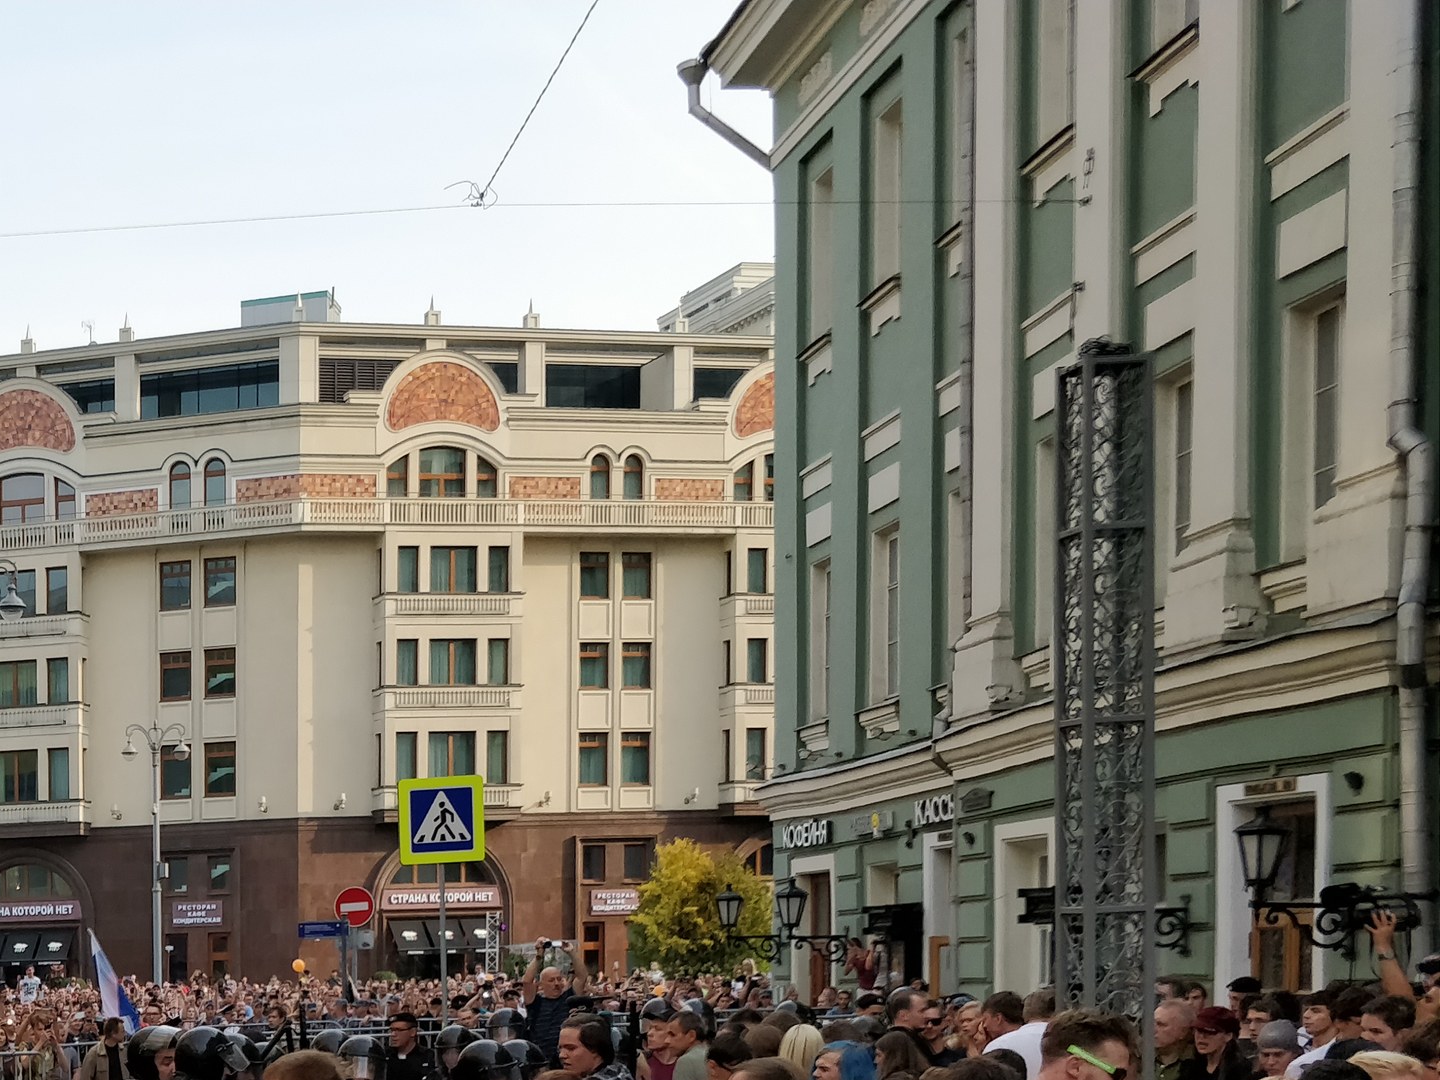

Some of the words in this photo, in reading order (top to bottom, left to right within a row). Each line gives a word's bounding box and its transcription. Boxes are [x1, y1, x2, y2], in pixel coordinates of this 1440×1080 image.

[782, 819, 827, 849] КОФЕЙНЯ
[391, 894, 428, 904] СТРАНА
[475, 892, 493, 902] НЕТ
[12, 904, 53, 915] КОТОРОЙ
[55, 905, 73, 915] НЕТ
